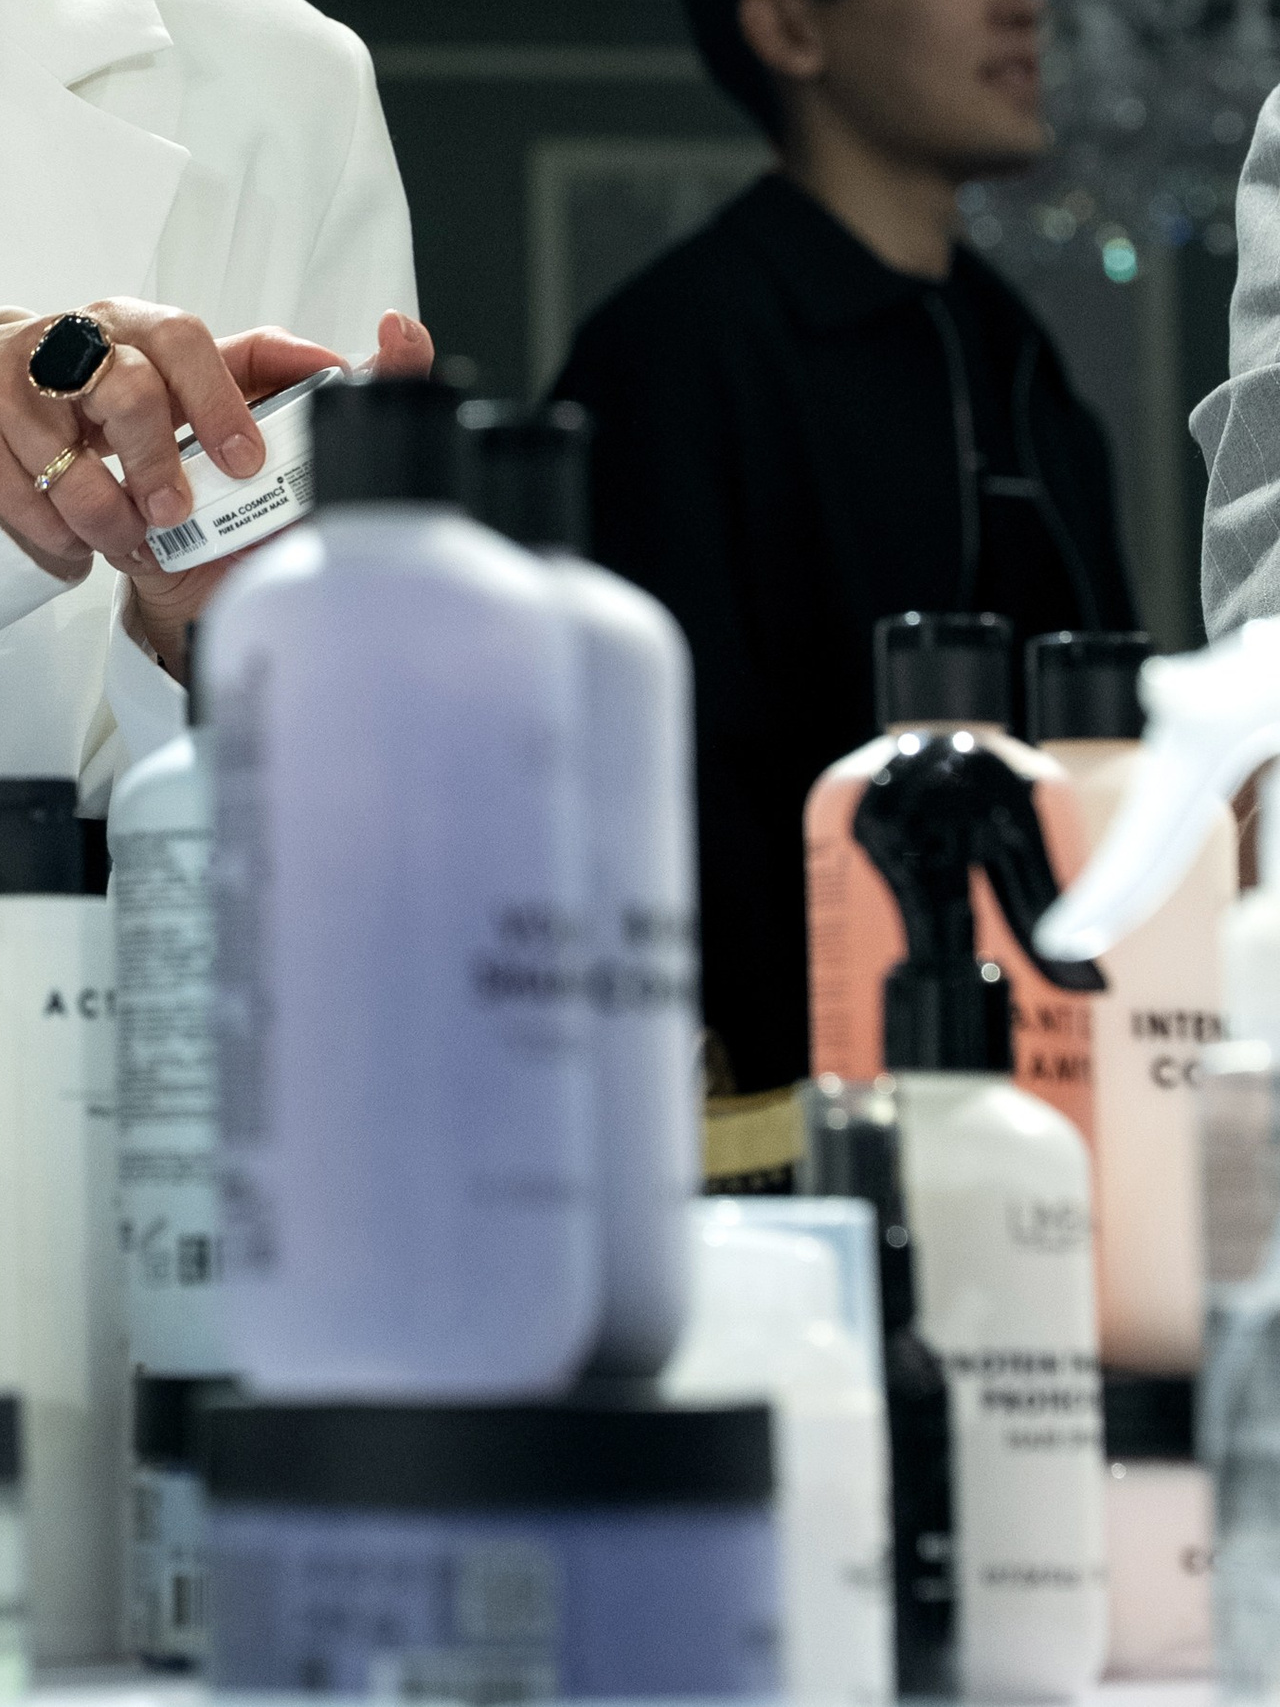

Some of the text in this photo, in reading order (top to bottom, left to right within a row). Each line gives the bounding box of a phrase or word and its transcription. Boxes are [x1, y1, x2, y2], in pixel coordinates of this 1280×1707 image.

[213, 486, 285, 528] LIMBA COSMETICS
[218, 496, 289, 536] PURE BASE HAIR MASK
